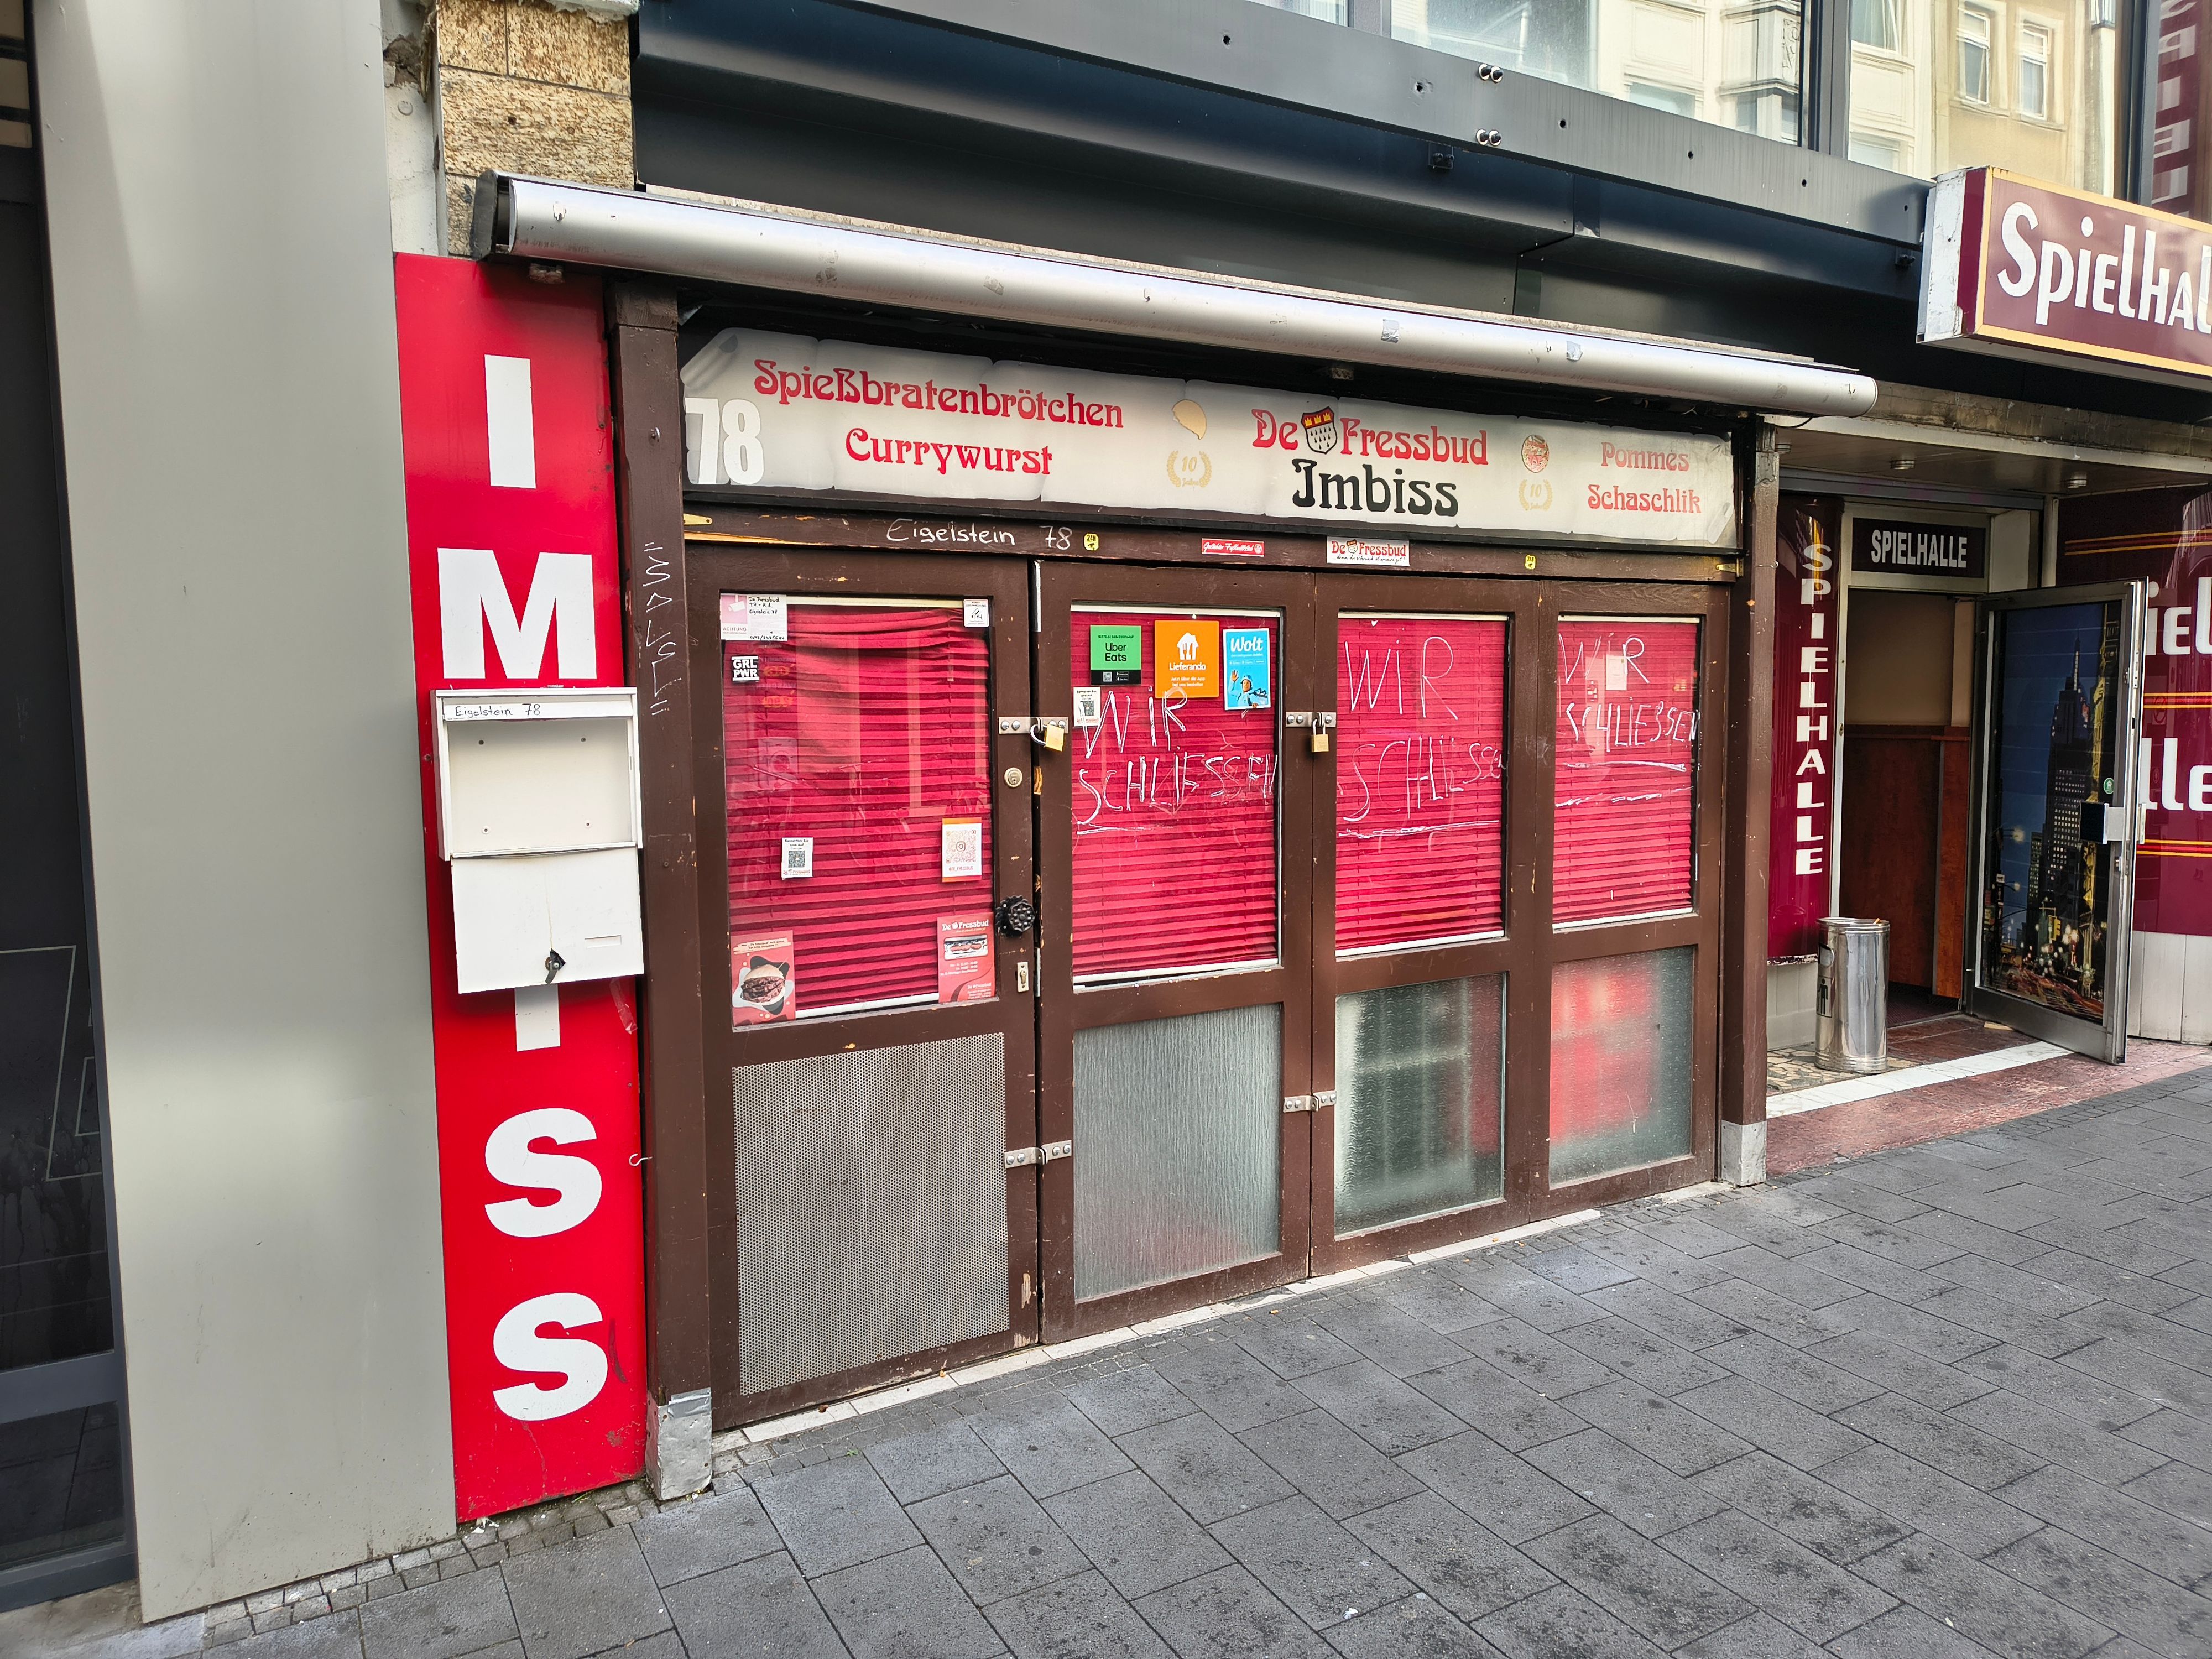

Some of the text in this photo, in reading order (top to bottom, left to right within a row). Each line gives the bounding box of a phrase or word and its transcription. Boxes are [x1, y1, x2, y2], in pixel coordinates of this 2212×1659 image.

[754, 358, 1124, 429] Spießbratenbrötchen
[685, 397, 765, 485] 78
[1251, 408, 1489, 466] De Fressbud
[845, 428, 1052, 474] Currywurst
[1600, 442, 1689, 473] Pommes
[1181, 455, 1197, 472] 10
[1292, 458, 1459, 517] Imbiss
[1530, 483, 1542, 498] 10
[1588, 483, 1702, 514] Schaschlik
[886, 518, 1072, 550] Eigelstein 78
[1332, 541, 1406, 557] De Fressbud
[1871, 529, 1968, 568] SPIELHALLE
[1105, 642, 1126, 651] Uber
[1230, 636, 1264, 652] Wolt
[733, 659, 758, 669] GRL
[1105, 653, 1127, 661] Eats
[1168, 661, 1207, 671] Lieferando
[733, 669, 758, 678] PWR
[455, 703, 541, 718] Eigelstein 78
[1795, 543, 1833, 876] SPIELHALLE
[437, 354, 608, 1422] IMISS
[942, 923, 951, 931] De
[958, 919, 989, 929] Fressbud
